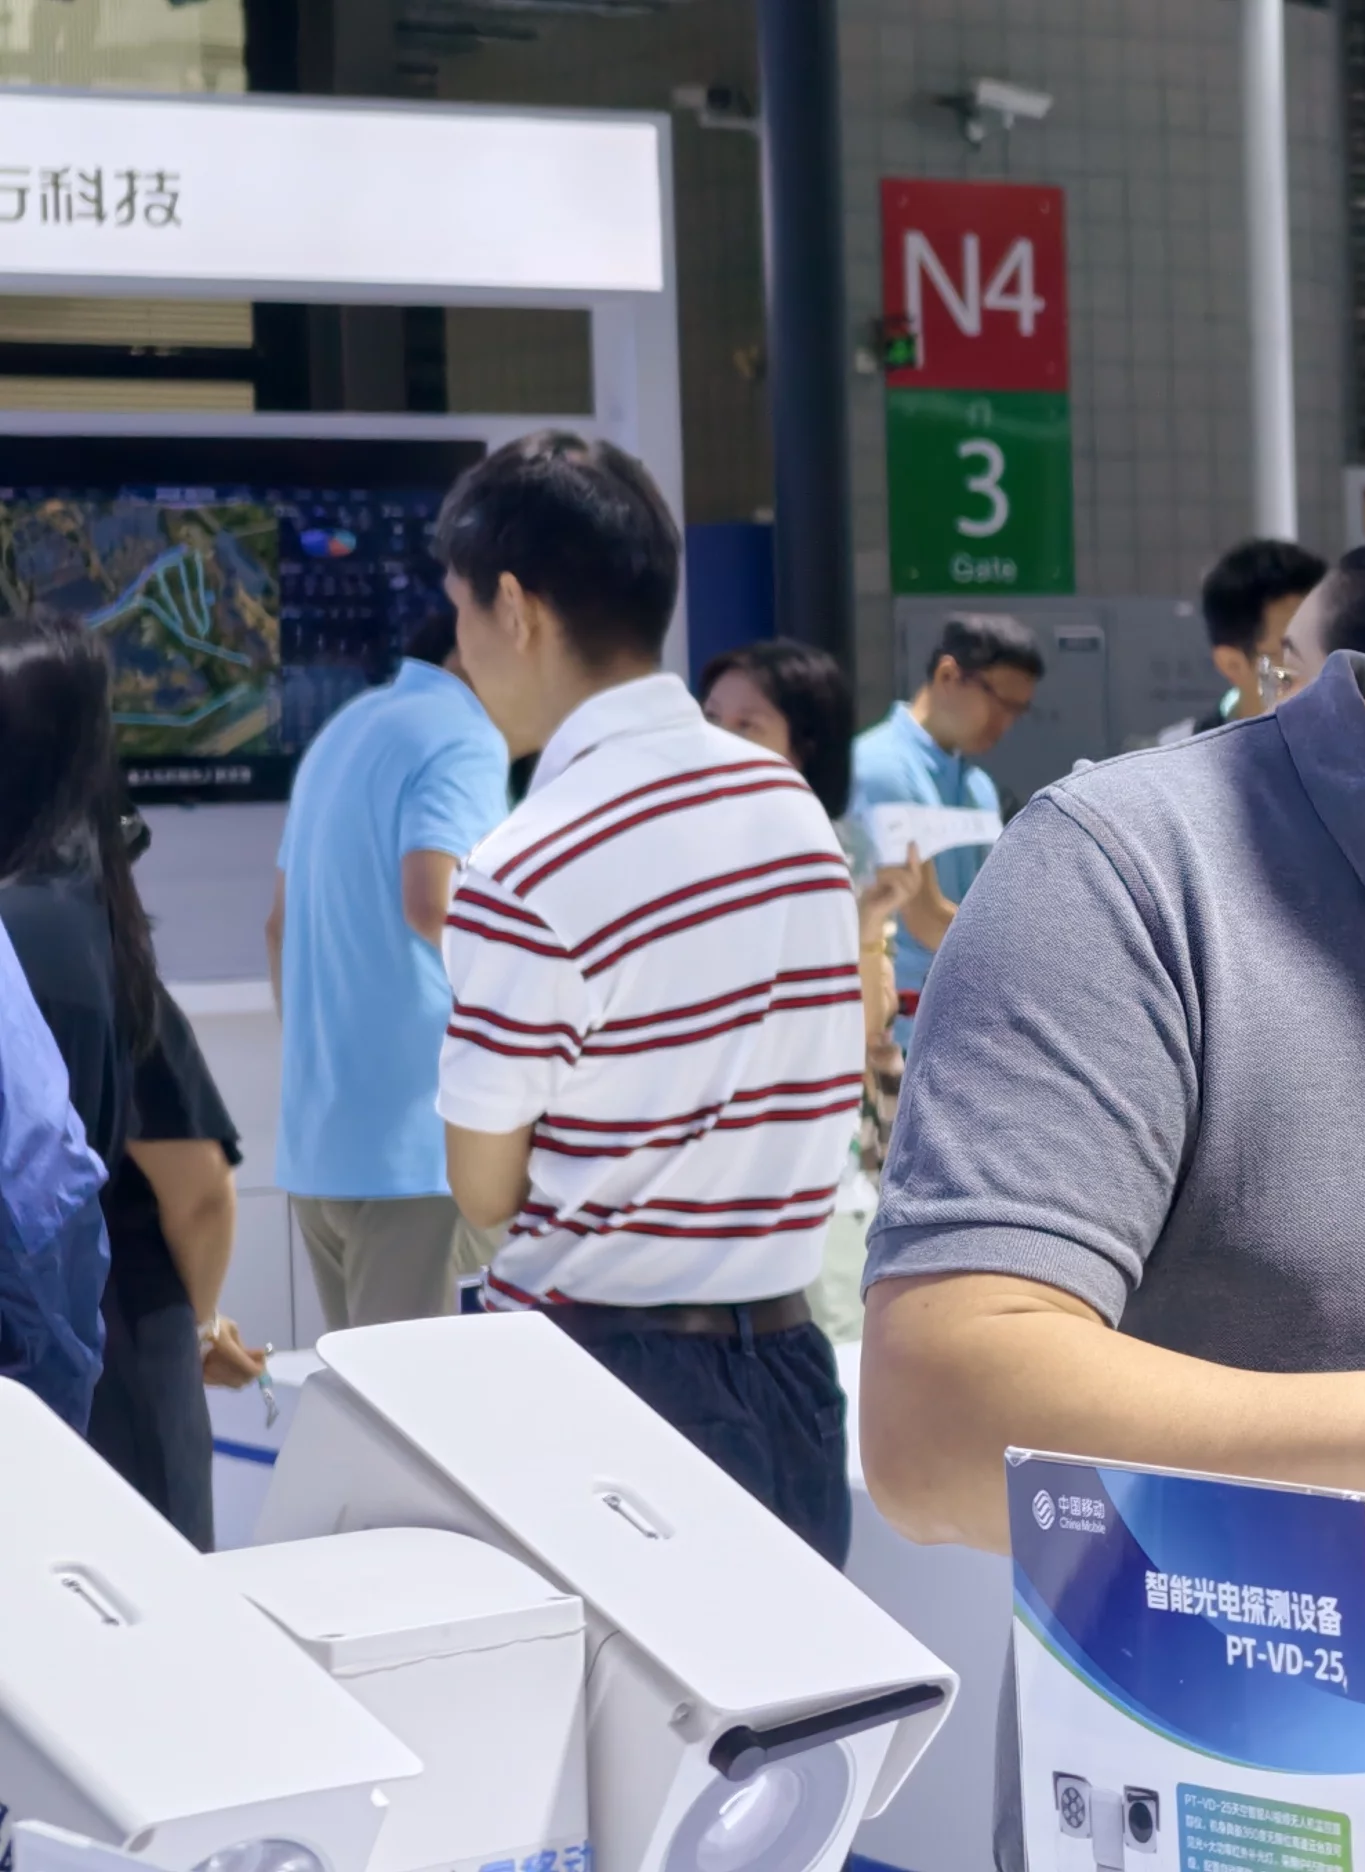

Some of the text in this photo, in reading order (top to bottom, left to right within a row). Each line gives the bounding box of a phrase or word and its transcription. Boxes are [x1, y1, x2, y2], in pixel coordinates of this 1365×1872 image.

[903, 230, 1045, 370] N4
[957, 438, 1010, 537] 3
[950, 551, 1018, 584] Gate
[1058, 1494, 1105, 1519] 中国移动
[1145, 1570, 1342, 1636] 智能光电探测设备
